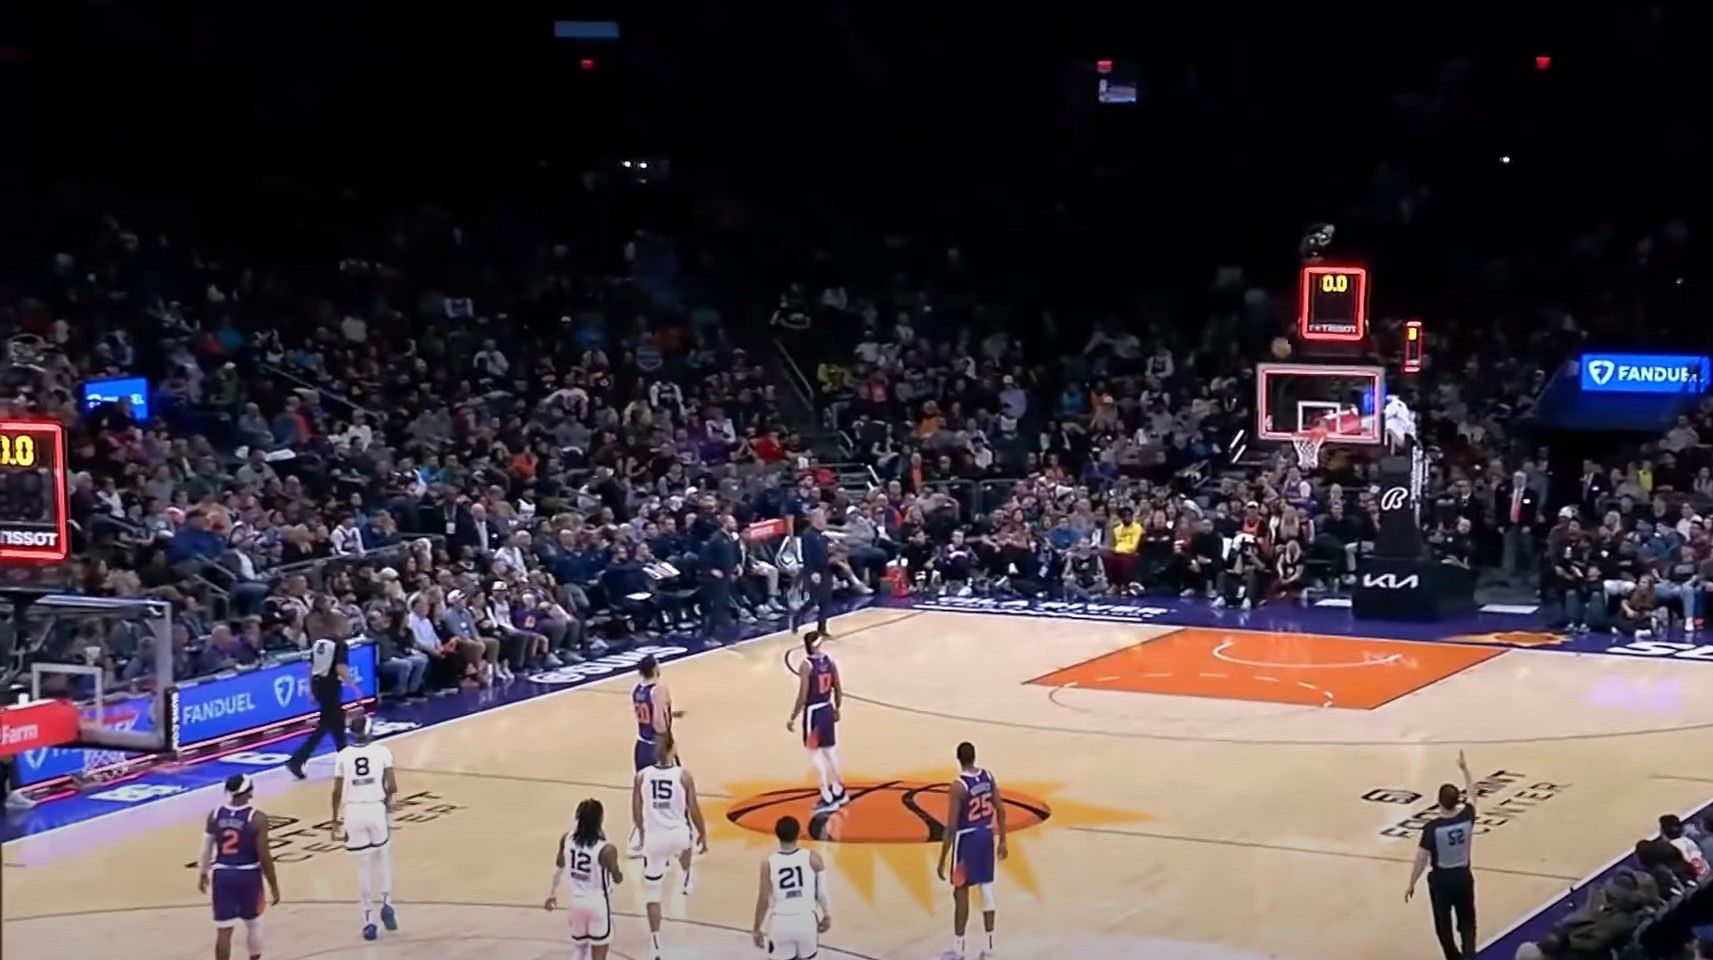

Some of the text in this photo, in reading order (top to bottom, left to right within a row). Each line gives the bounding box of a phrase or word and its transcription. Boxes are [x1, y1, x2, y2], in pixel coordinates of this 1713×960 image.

[1322, 275, 1348, 292] 0.0
[1618, 365, 1704, 383] FANDUE
[1363, 572, 1419, 588] KIA
[183, 692, 256, 725] FANDUEL
[354, 757, 370, 776] 8
[651, 779, 673, 800] 15
[968, 796, 995, 822] 25
[220, 830, 240, 855] 2
[570, 849, 592, 874] 12
[778, 866, 805, 890] 21
